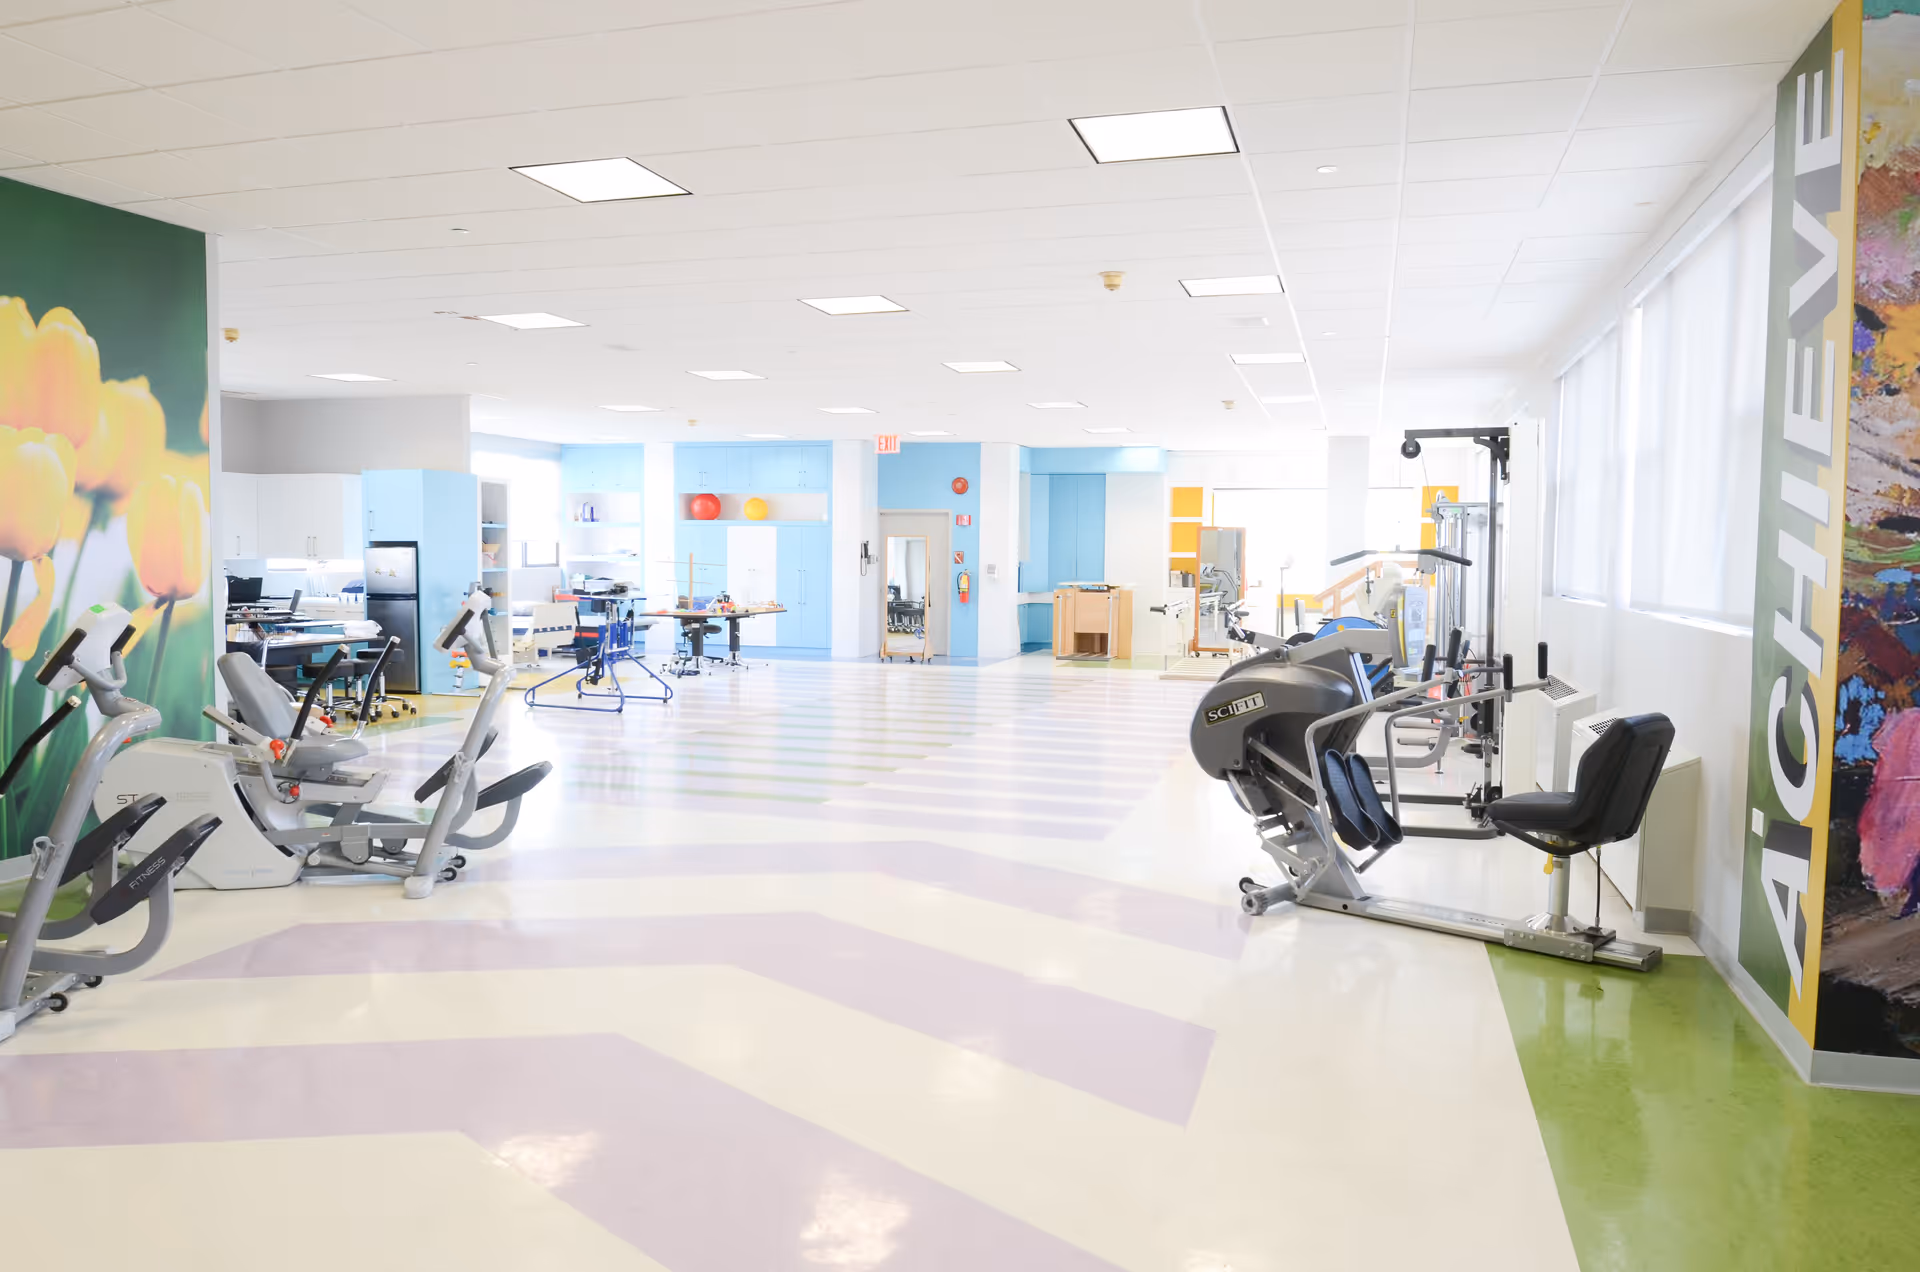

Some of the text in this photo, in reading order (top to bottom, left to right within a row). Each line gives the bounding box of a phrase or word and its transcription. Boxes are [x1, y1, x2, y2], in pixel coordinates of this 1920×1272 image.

[878, 436, 897, 451] EXIT
[1761, 48, 1844, 1002] ACHIEVE
[1208, 696, 1260, 722] SCIFIT
[129, 856, 166, 890] FITNESS
